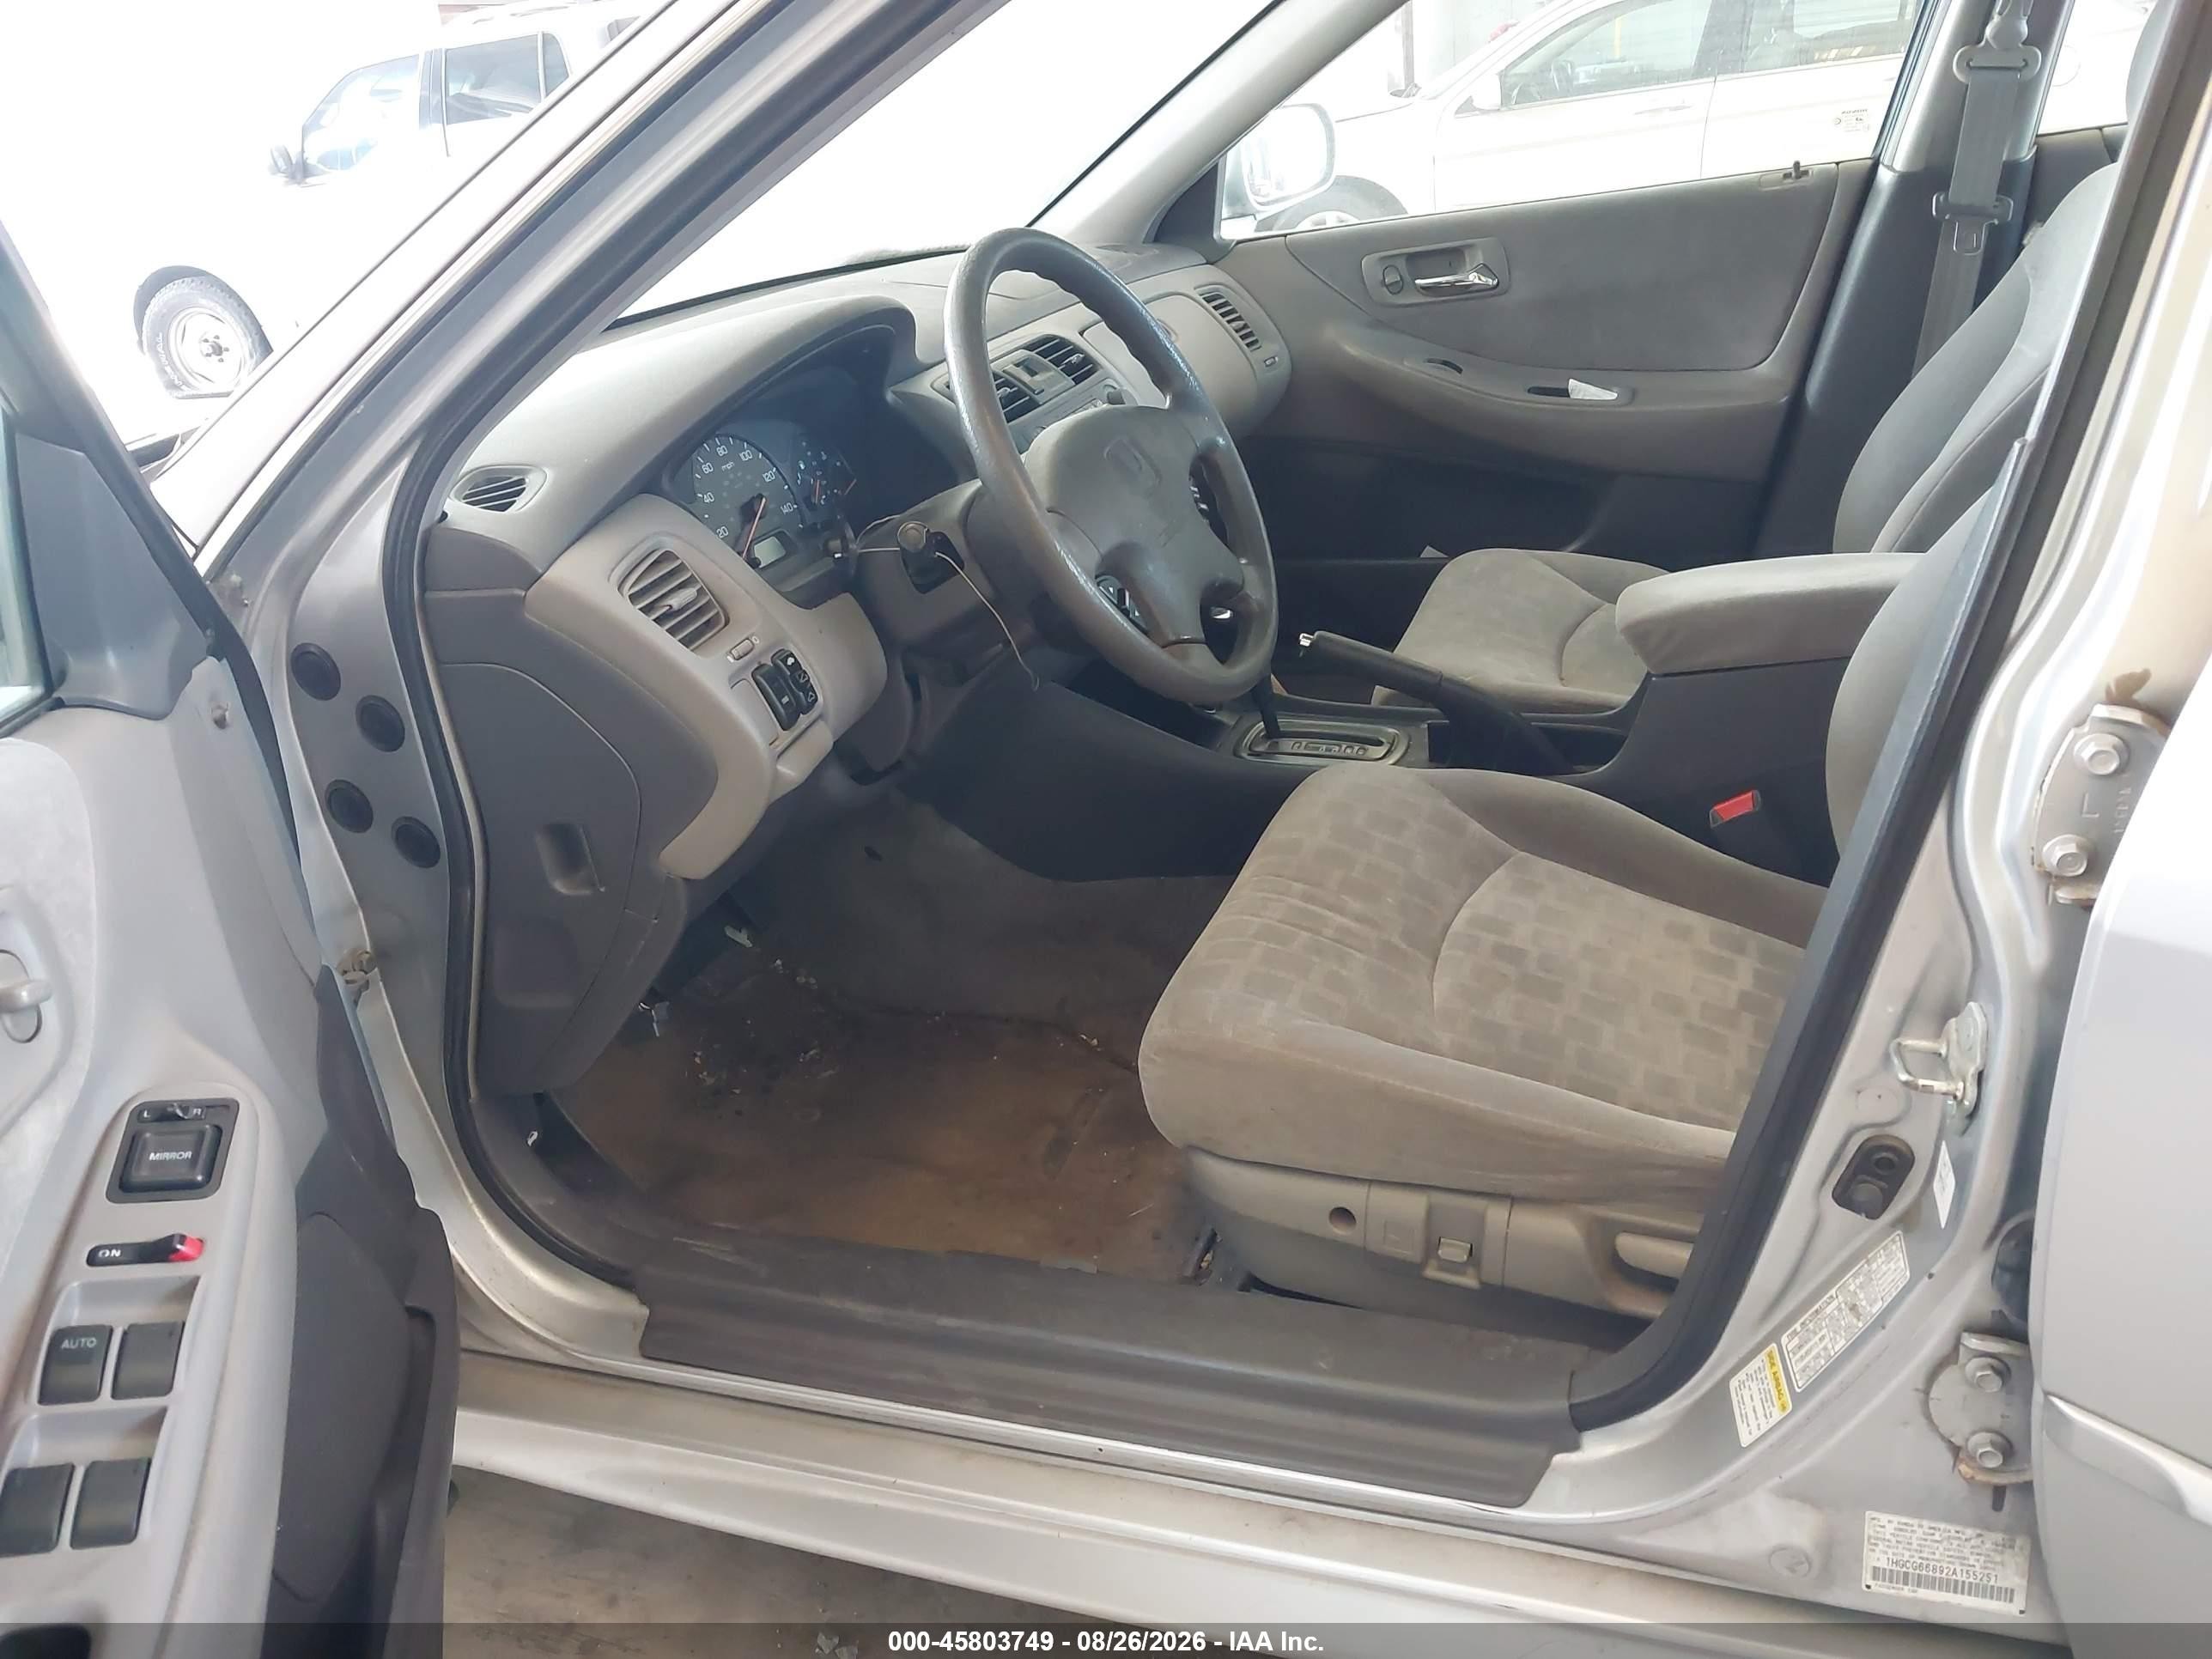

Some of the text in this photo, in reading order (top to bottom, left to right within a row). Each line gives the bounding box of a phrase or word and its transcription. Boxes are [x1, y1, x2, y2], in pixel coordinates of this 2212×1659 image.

[716, 446, 728, 457] 80
[739, 450, 753, 461] 100
[702, 462, 714, 474] 60
[721, 461, 735, 471] mph
[763, 471, 775, 483] 120
[703, 492, 714, 503] 40
[780, 502, 793, 515] 140
[716, 526, 729, 538] 20
[192, 1108, 202, 1116] R
[149, 1151, 192, 1161] MIRROR
[98, 1248, 121, 1259] ON
[61, 1336, 97, 1350] AUTO
